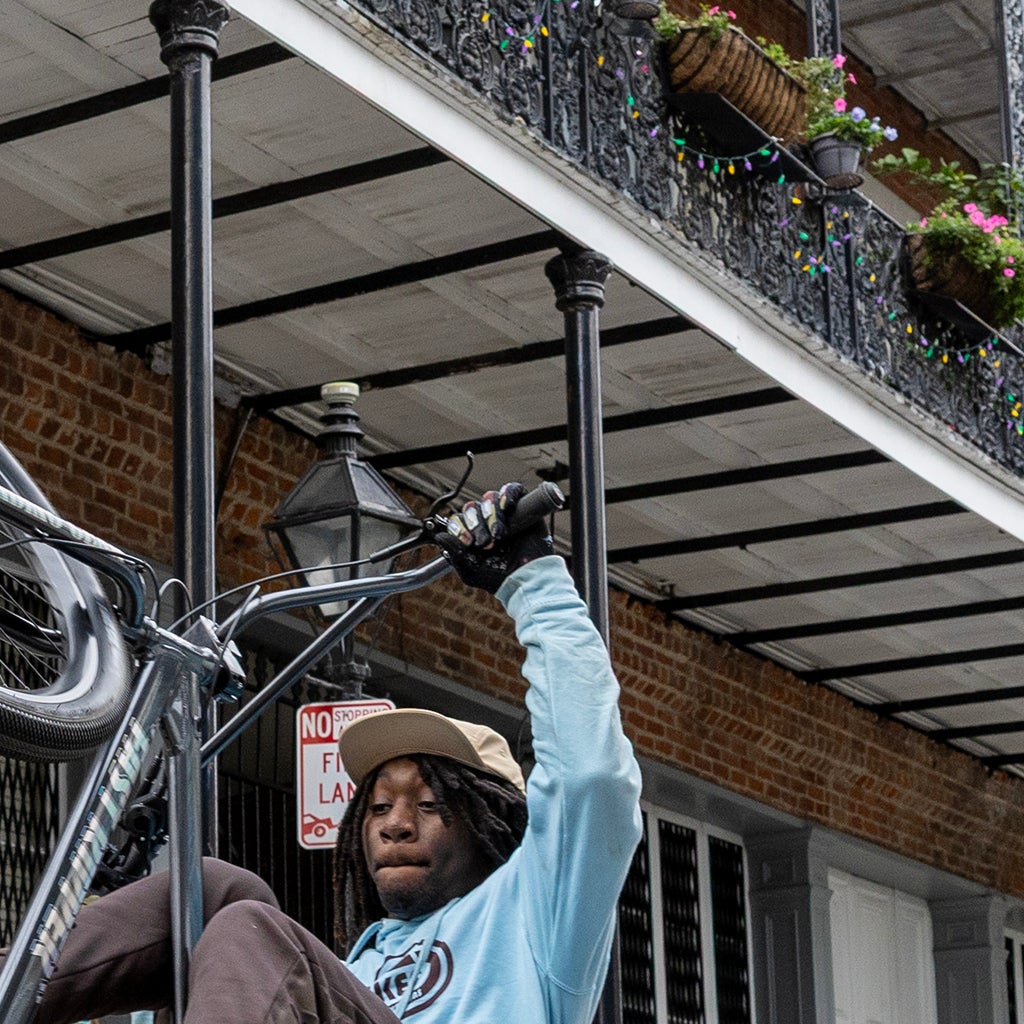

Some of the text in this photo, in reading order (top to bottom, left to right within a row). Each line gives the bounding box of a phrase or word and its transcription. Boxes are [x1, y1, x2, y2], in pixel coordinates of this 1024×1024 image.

[302, 711, 332, 738] NO
[334, 708, 389, 722] STOPP
[319, 782, 357, 805] LAN
[30, 716, 149, 977] FAST RIPPER
